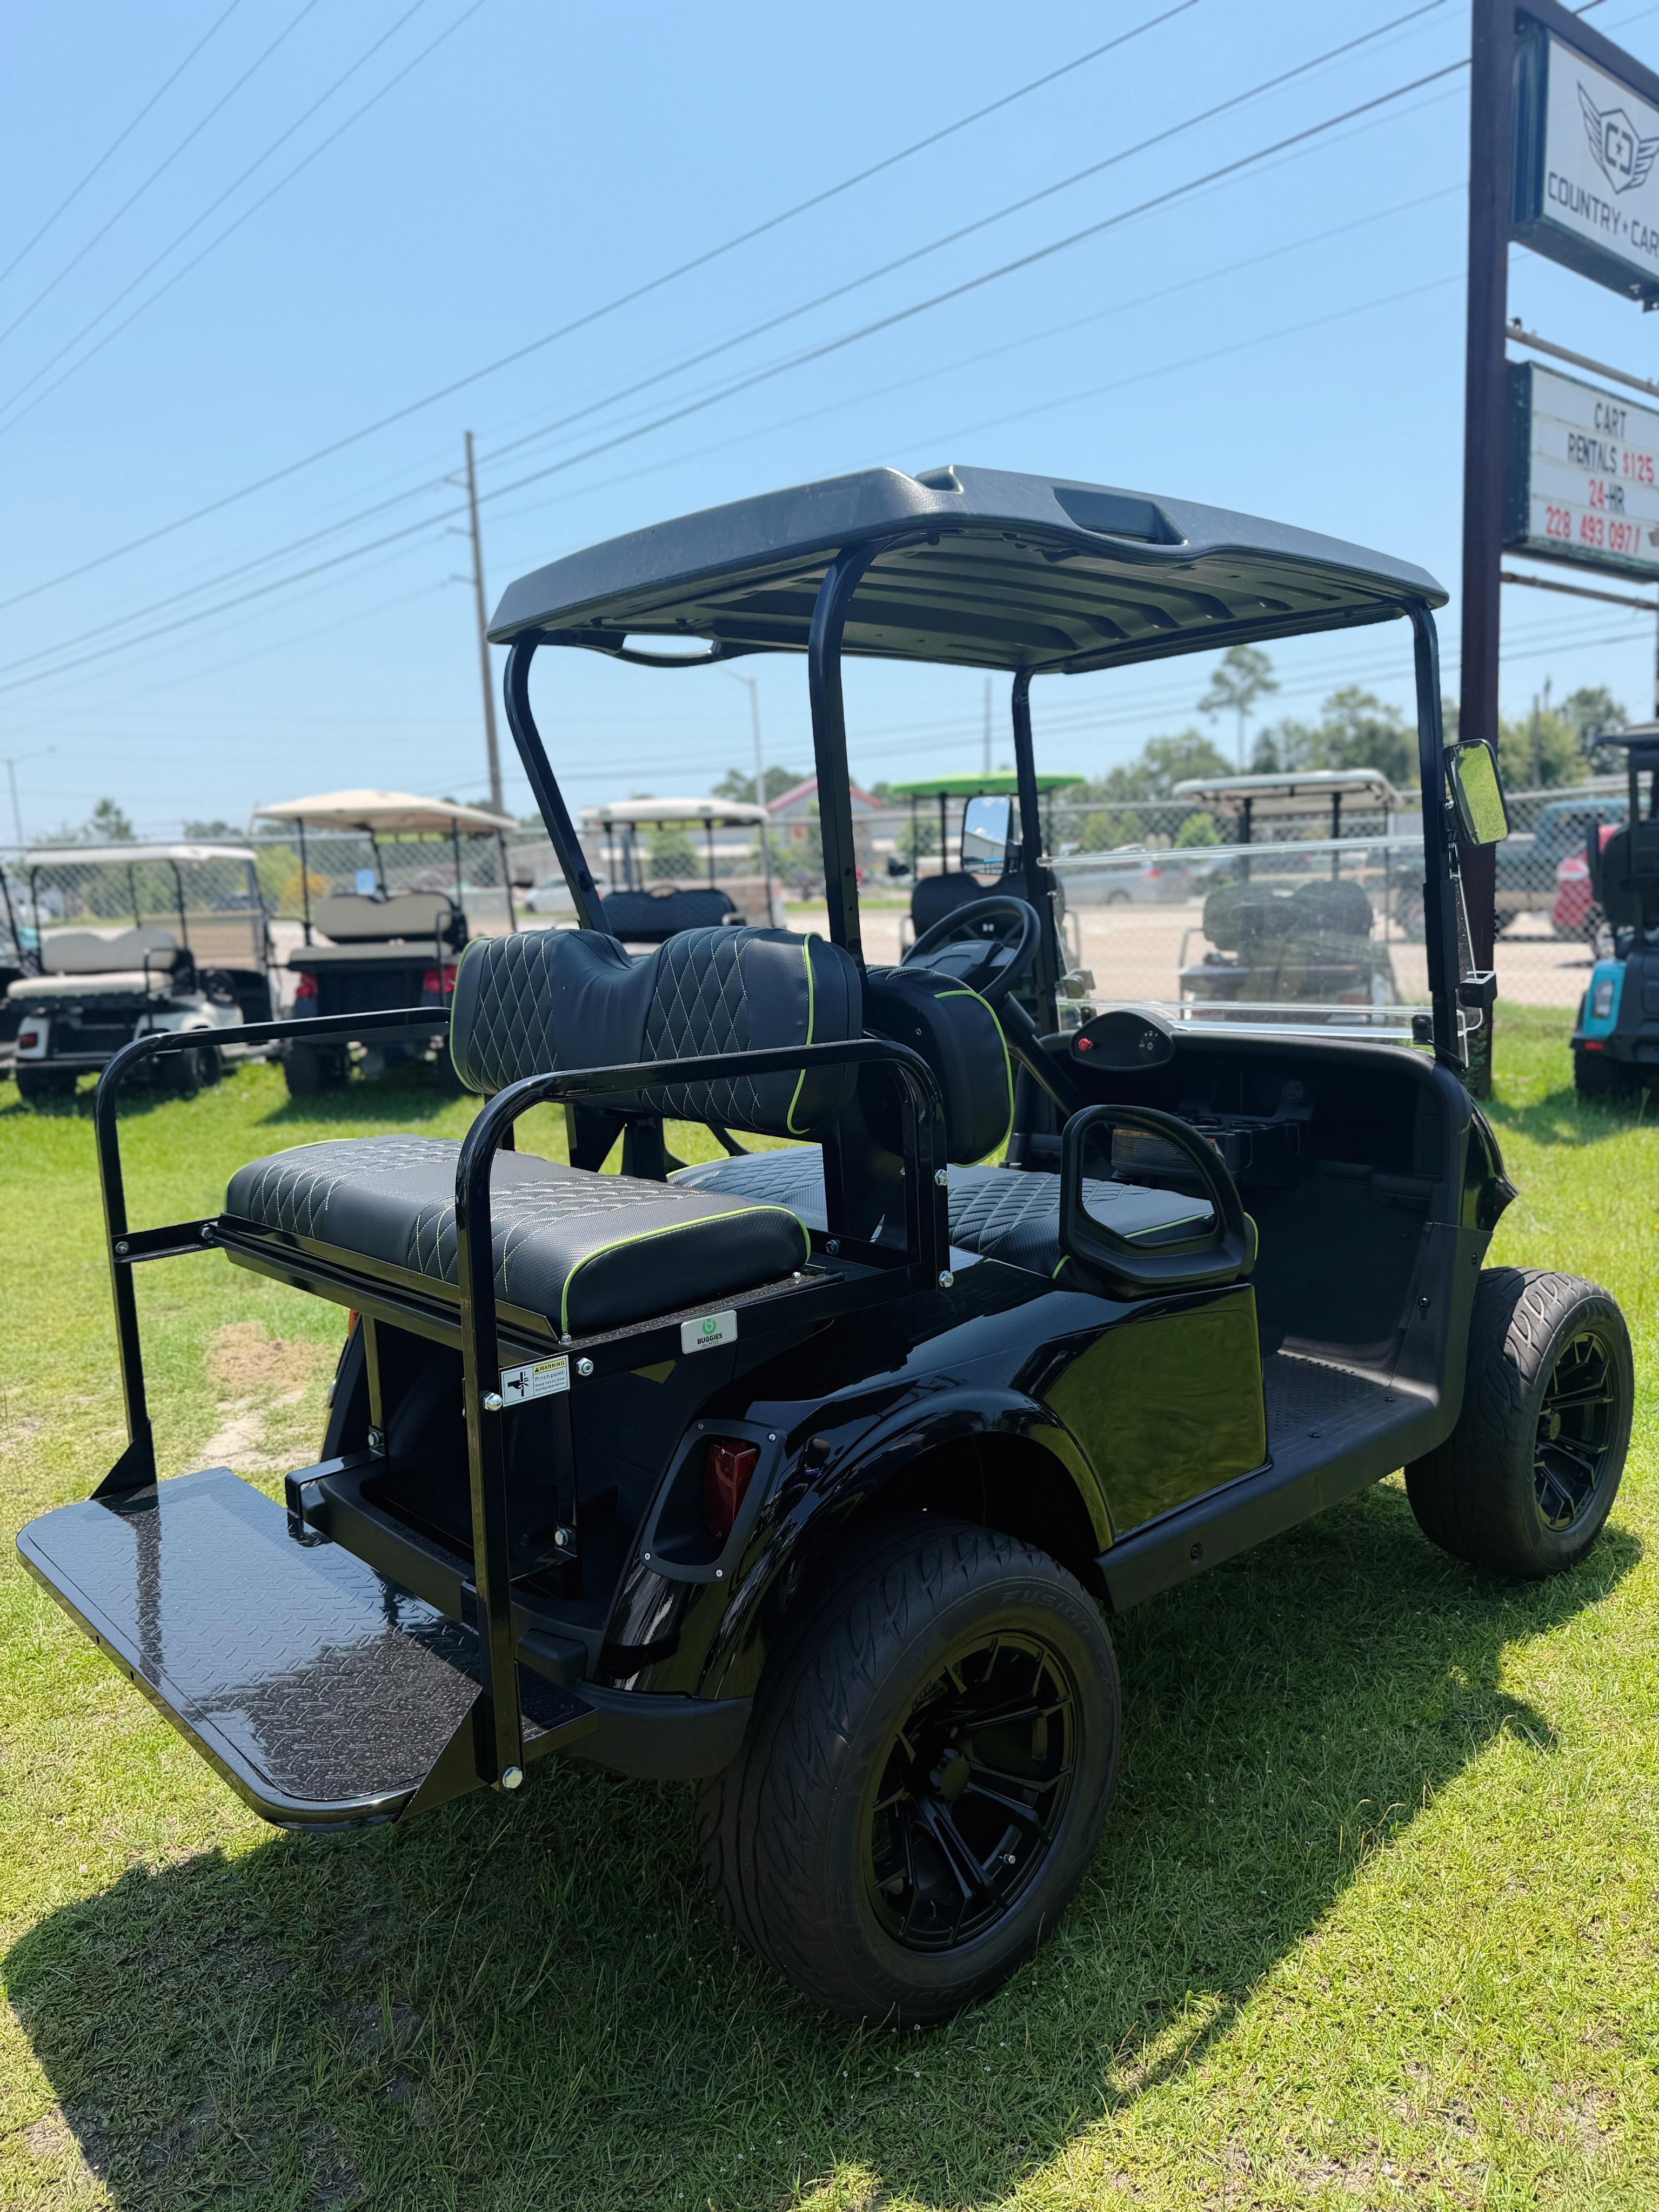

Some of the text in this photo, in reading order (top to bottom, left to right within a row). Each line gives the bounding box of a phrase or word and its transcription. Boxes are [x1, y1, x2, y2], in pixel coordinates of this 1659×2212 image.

[1548, 171, 1621, 235] COUNTRY
[1594, 402, 1626, 437] CART
[1568, 433, 1617, 473] RENTALS
[1546, 506, 1641, 554] 228 493 0971
[697, 1332, 723, 1345] BUGGIES
[539, 1360, 564, 1371] WARNING
